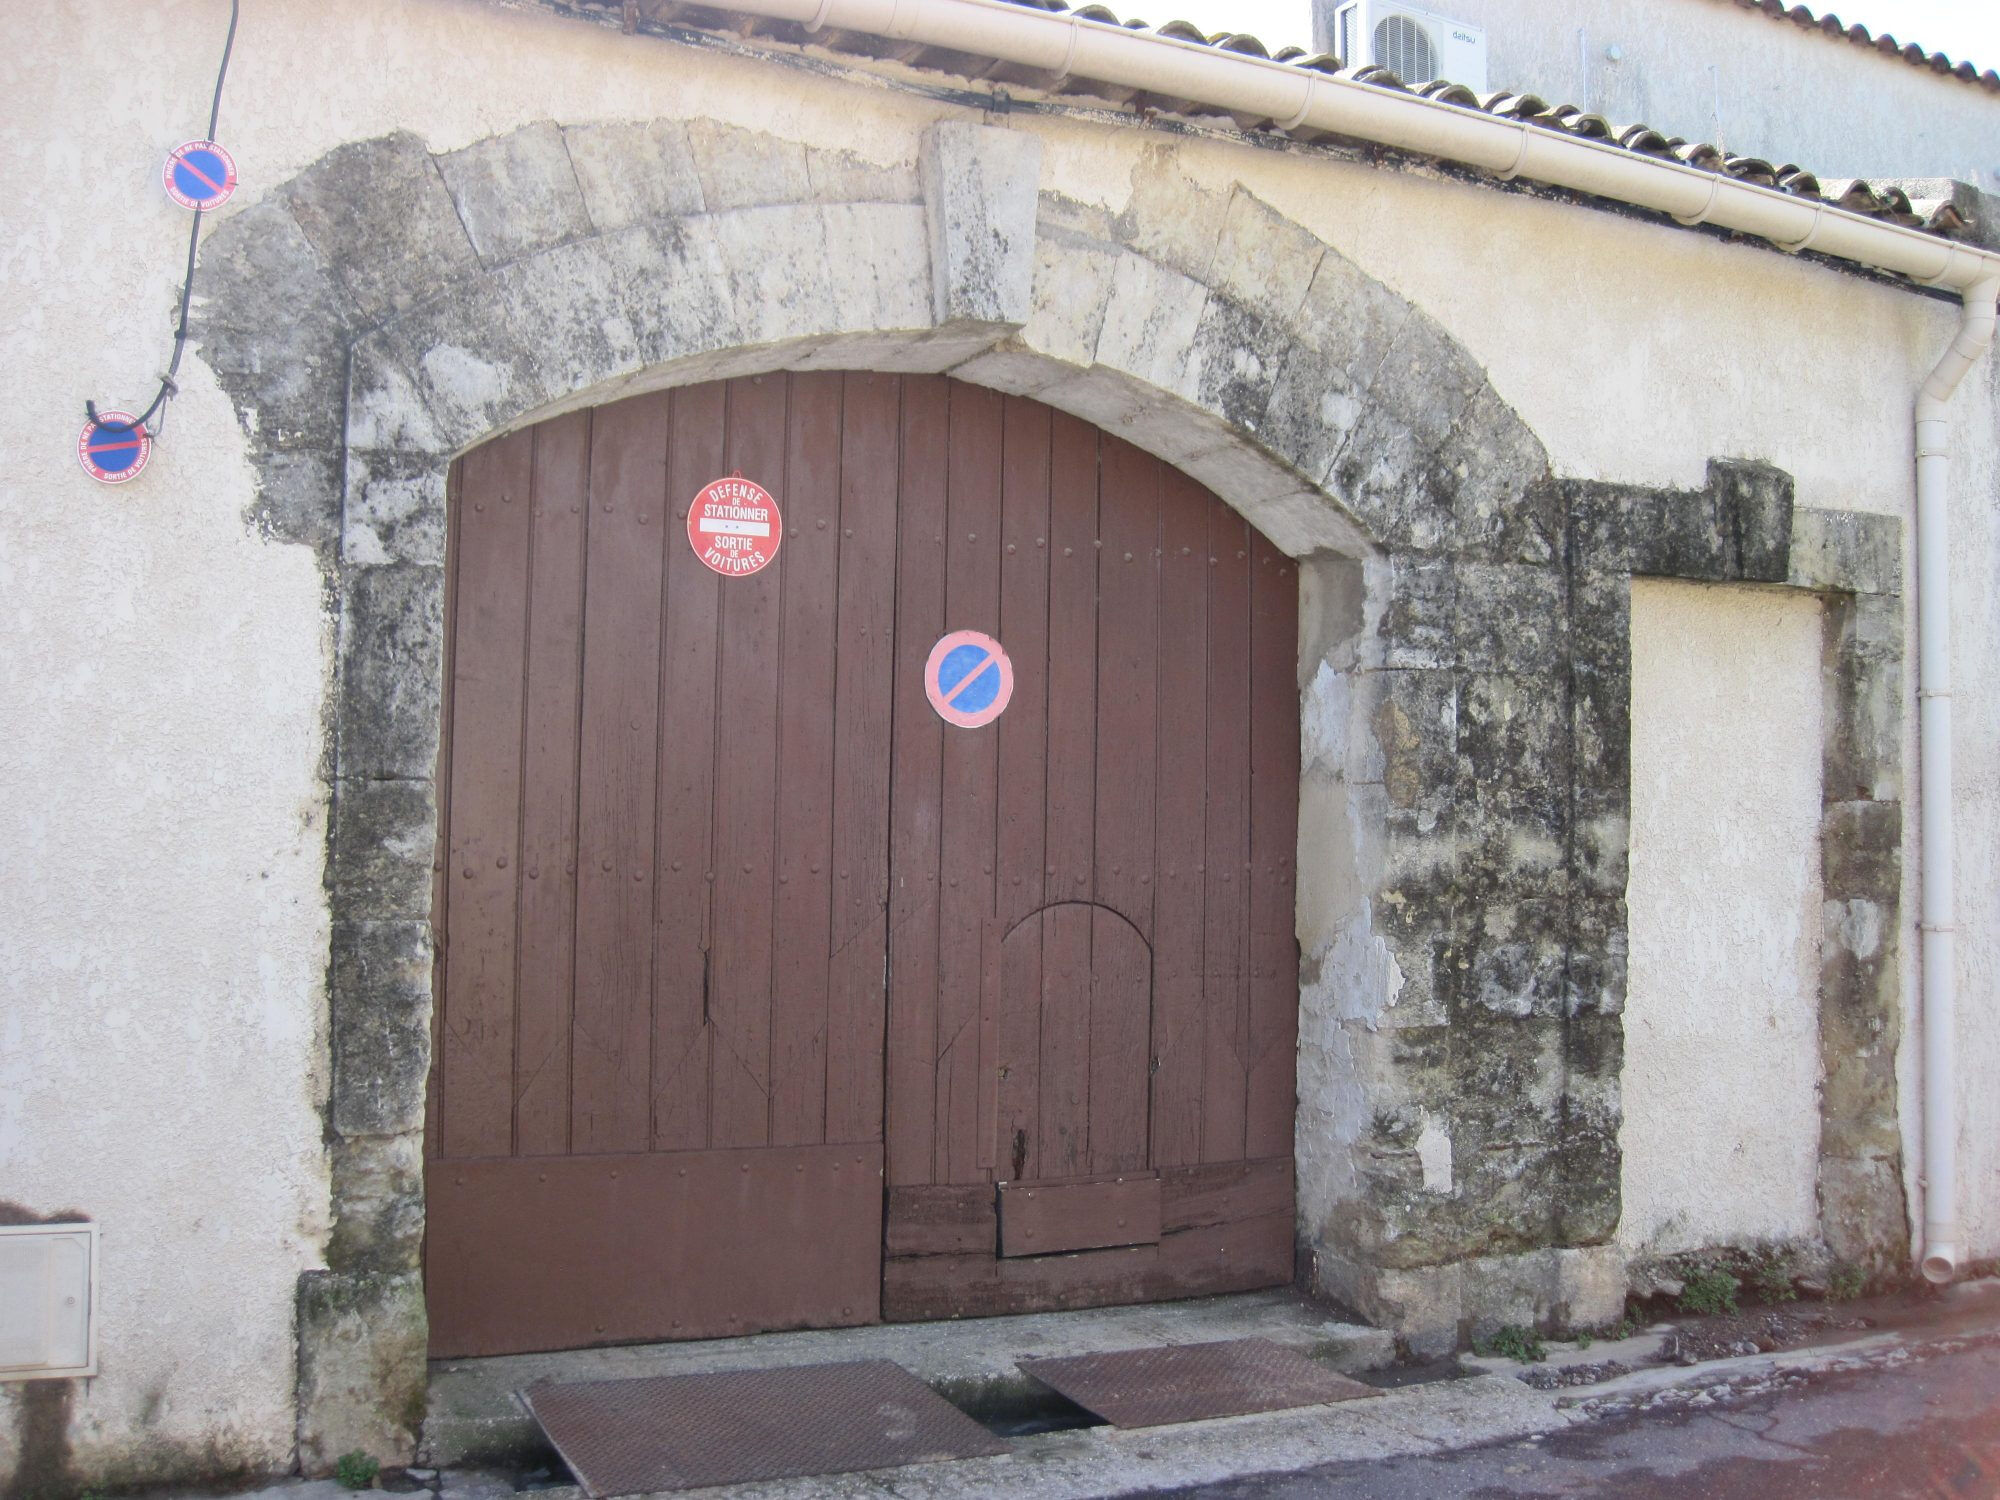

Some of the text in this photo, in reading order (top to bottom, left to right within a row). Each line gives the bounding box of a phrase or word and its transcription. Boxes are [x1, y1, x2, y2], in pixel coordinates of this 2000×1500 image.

[99, 413, 136, 424] STATIONNE
[81, 432, 90, 441] NE
[80, 441, 86, 449] DE
[128, 466, 137, 476] DE
[136, 438, 147, 468] VOITURES
[709, 483, 763, 504] DEFENSE
[732, 497, 741, 506] DE
[704, 504, 768, 521] STATIONNER
[714, 535, 753, 551] SORTIE
[704, 547, 765, 572] VOITURES
[730, 549, 739, 558] DE
